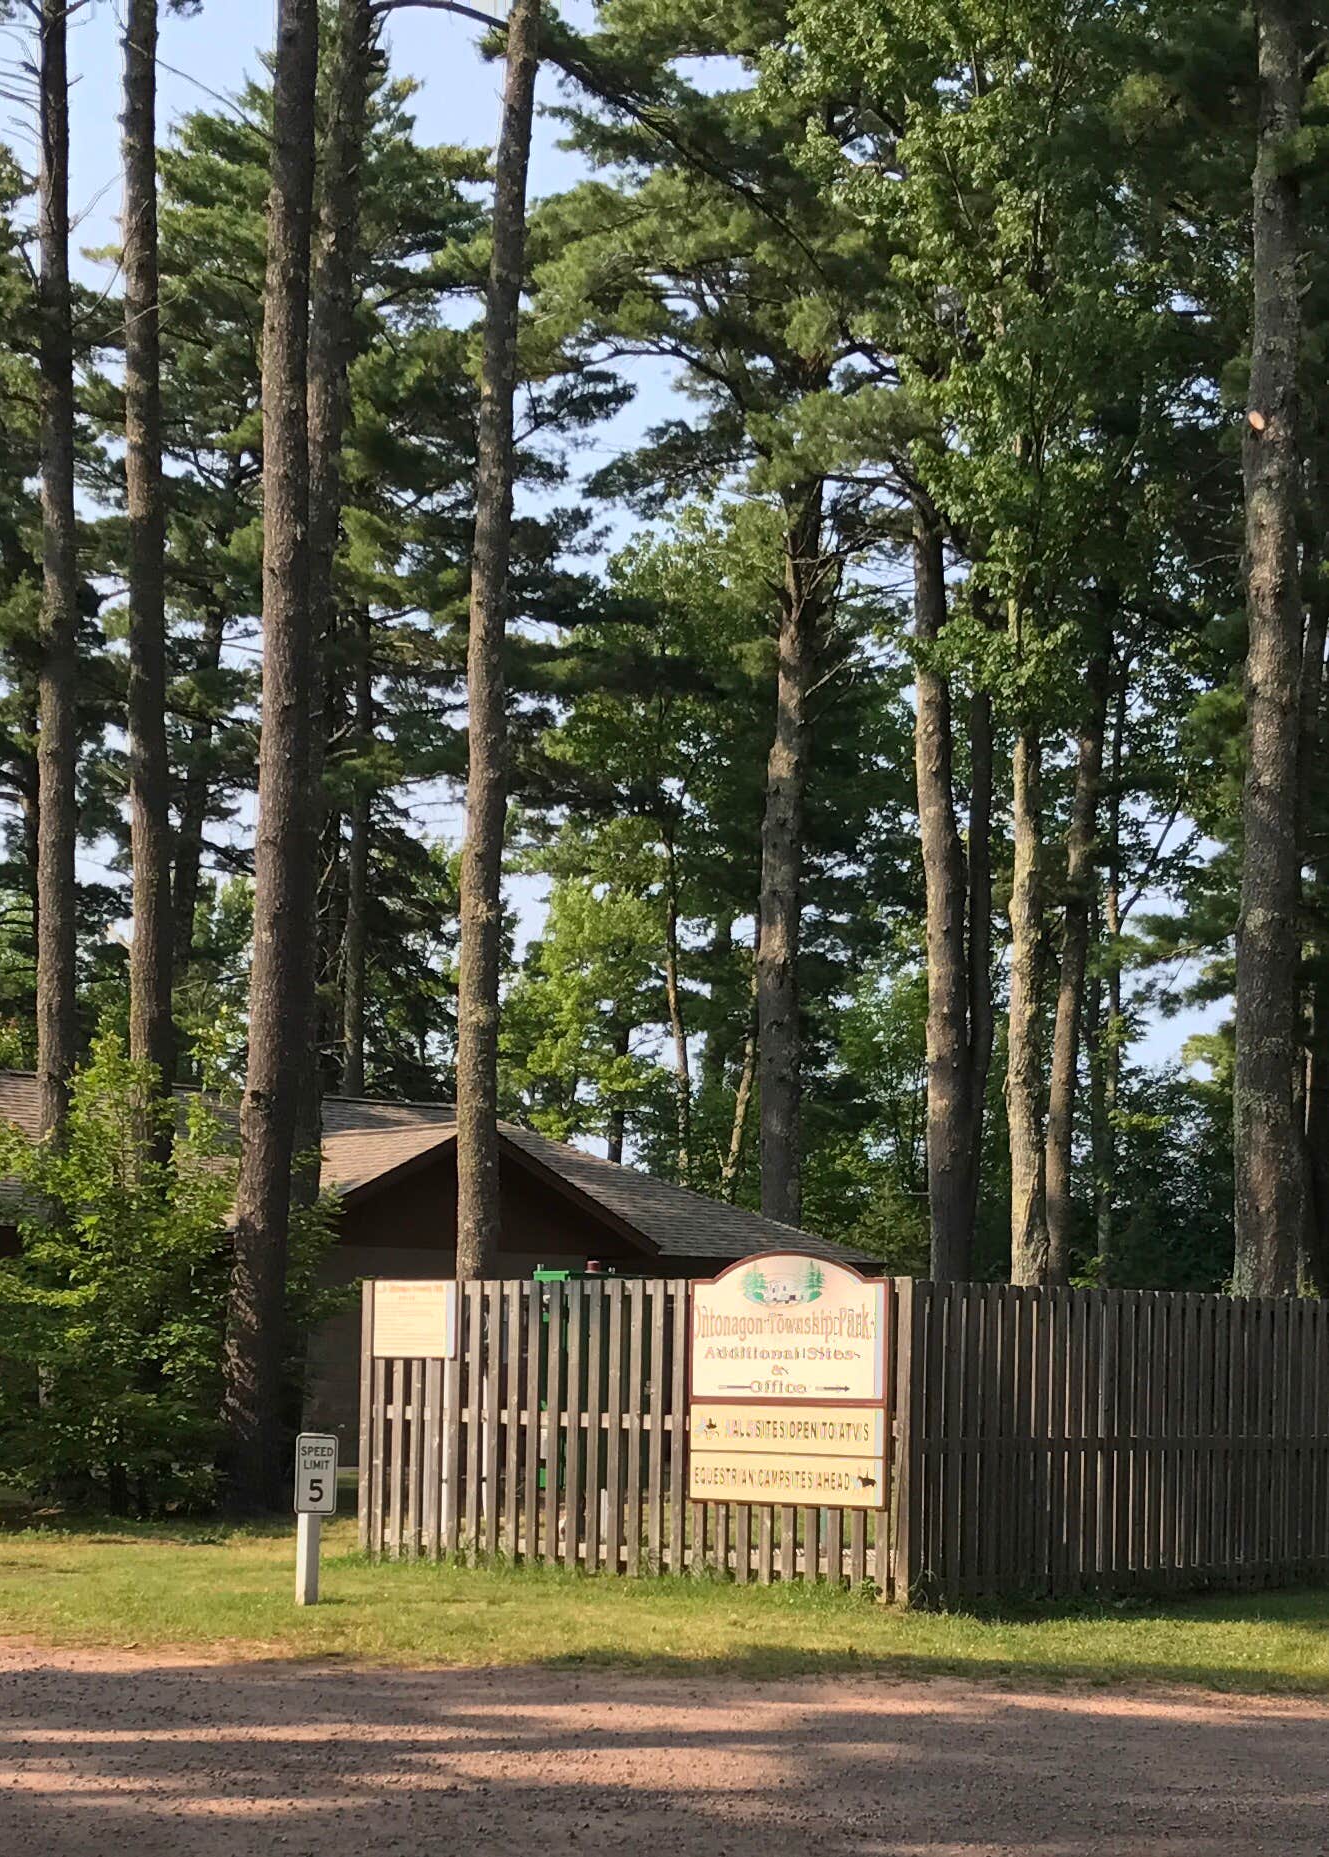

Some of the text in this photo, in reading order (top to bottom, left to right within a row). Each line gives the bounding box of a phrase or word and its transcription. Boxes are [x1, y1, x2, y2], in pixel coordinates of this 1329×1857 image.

[767, 1311, 833, 1343] Township
[839, 1302, 870, 1340] Park
[704, 1346, 855, 1361] Additional Sites
[750, 1380, 808, 1394] Office
[755, 1420, 785, 1439] SITES
[789, 1420, 817, 1439] OPEN
[821, 1421, 835, 1440] TO
[301, 1446, 334, 1457] SPEED
[303, 1460, 330, 1470] LIMIT
[758, 1469, 813, 1488] CAMPSITES
[816, 1471, 850, 1491] AHEAD
[309, 1479, 324, 1502] 5
